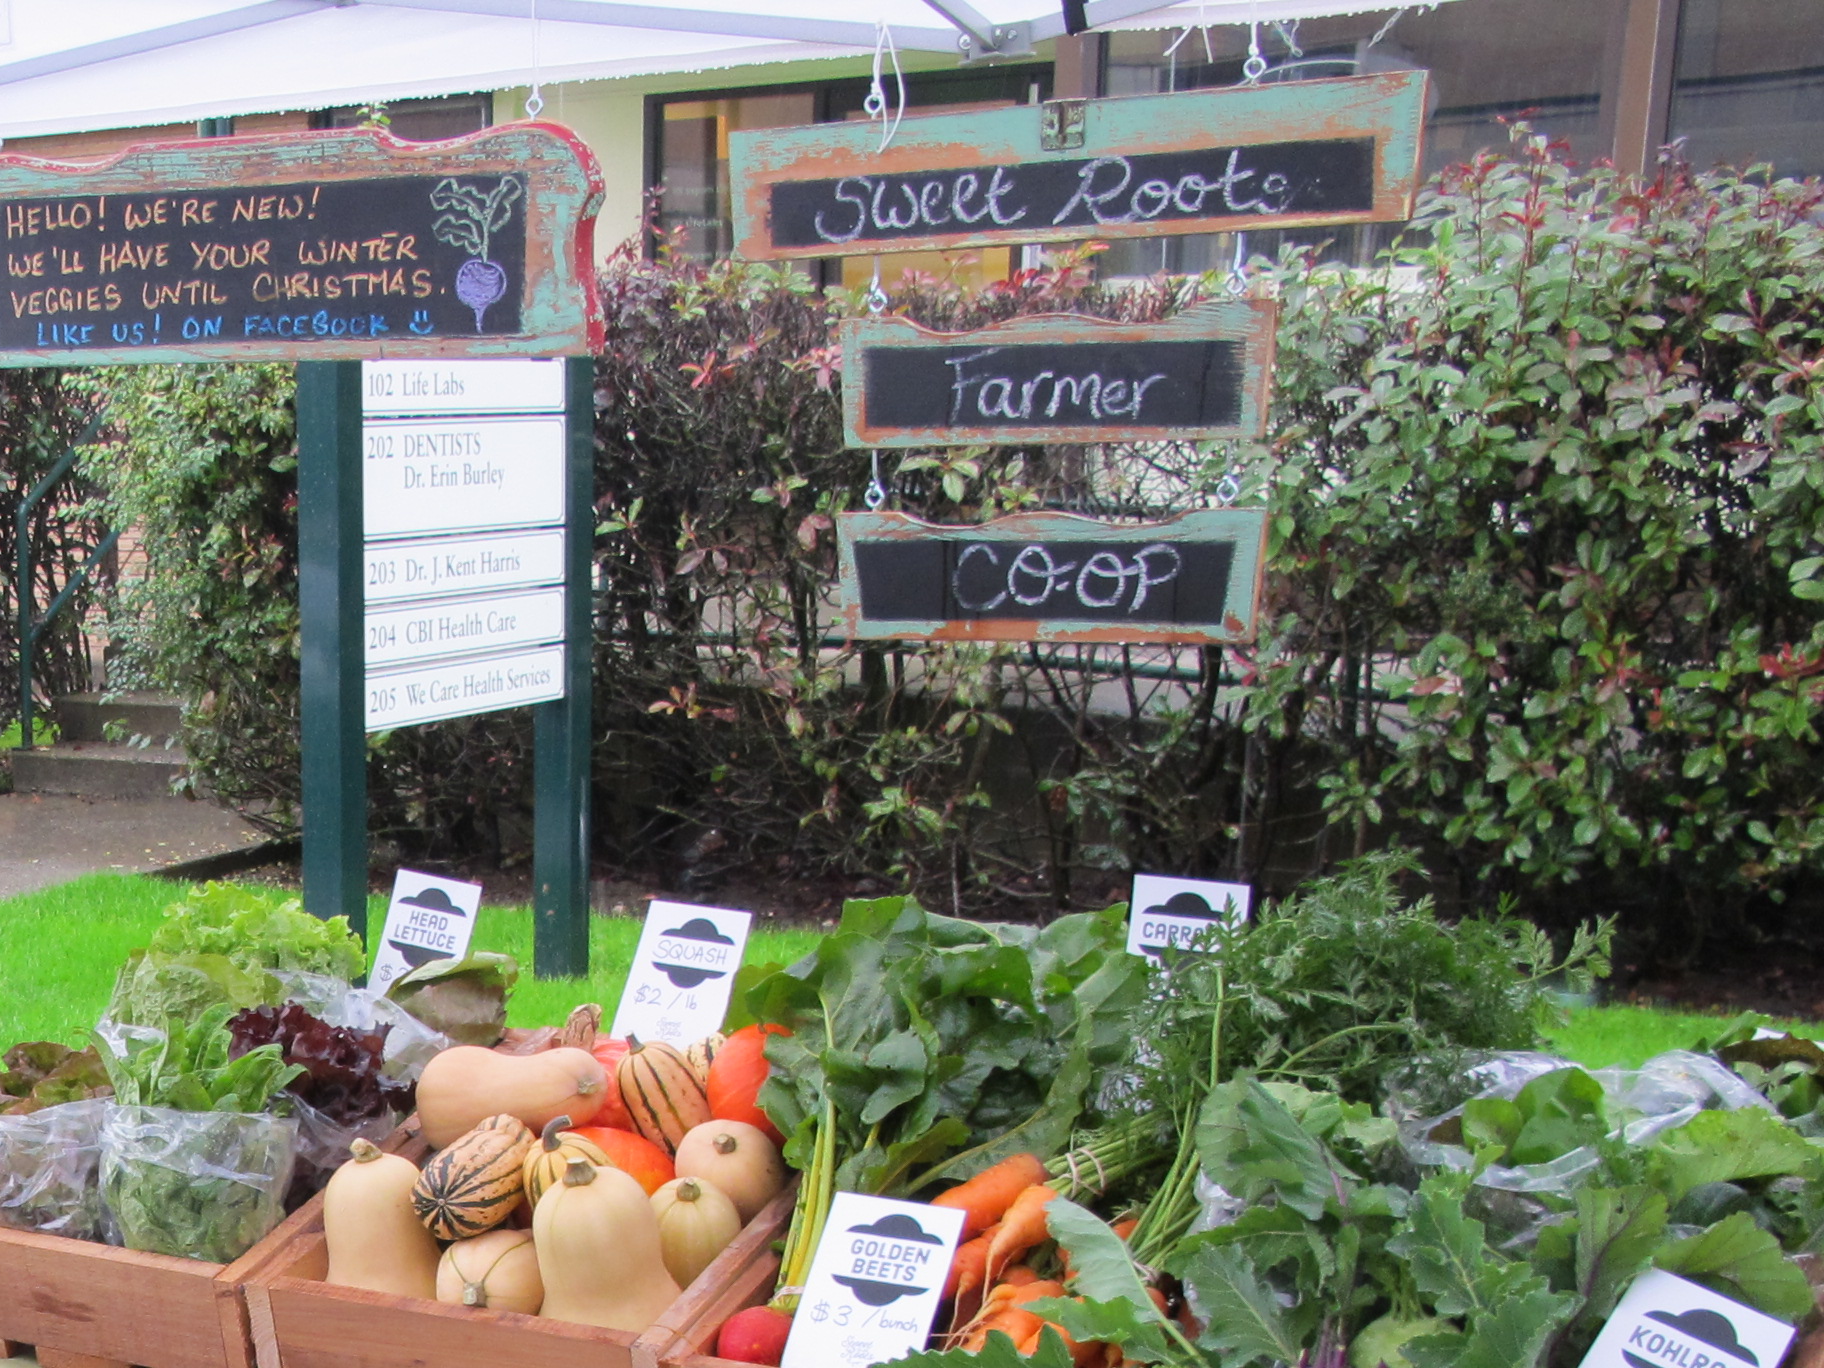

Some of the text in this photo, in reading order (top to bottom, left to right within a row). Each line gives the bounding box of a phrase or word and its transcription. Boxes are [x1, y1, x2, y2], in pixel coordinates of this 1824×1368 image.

[6, 186, 320, 239] HELLO! WE'RE NEW!
[814, 148, 1292, 244] Sweet Roots
[8, 231, 418, 277] WE'LL HAVE YOUR WINTER
[10, 267, 446, 318] VEGGIES UNTIL CHRISTMAS.
[36, 310, 389, 346] LIKE US! ON FACEBOOK
[368, 371, 465, 397] 102 Life Labs
[944, 347, 1166, 421] Farmer
[367, 432, 481, 459] 202 DENTISTS
[403, 461, 505, 491] Dr. Erin Burley
[369, 549, 521, 586] 203 Dr. J. Kent Harris
[369, 611, 517, 649] 204 CBI Health Care
[369, 665, 551, 714] 205 We Care Health Services
[393, 924, 456, 950] LETTUCE
[409, 910, 448, 932] HEAD
[652, 939, 728, 965] SQUASH
[850, 1238, 931, 1264] GOLDEN
[851, 1258, 917, 1282] BEETS
